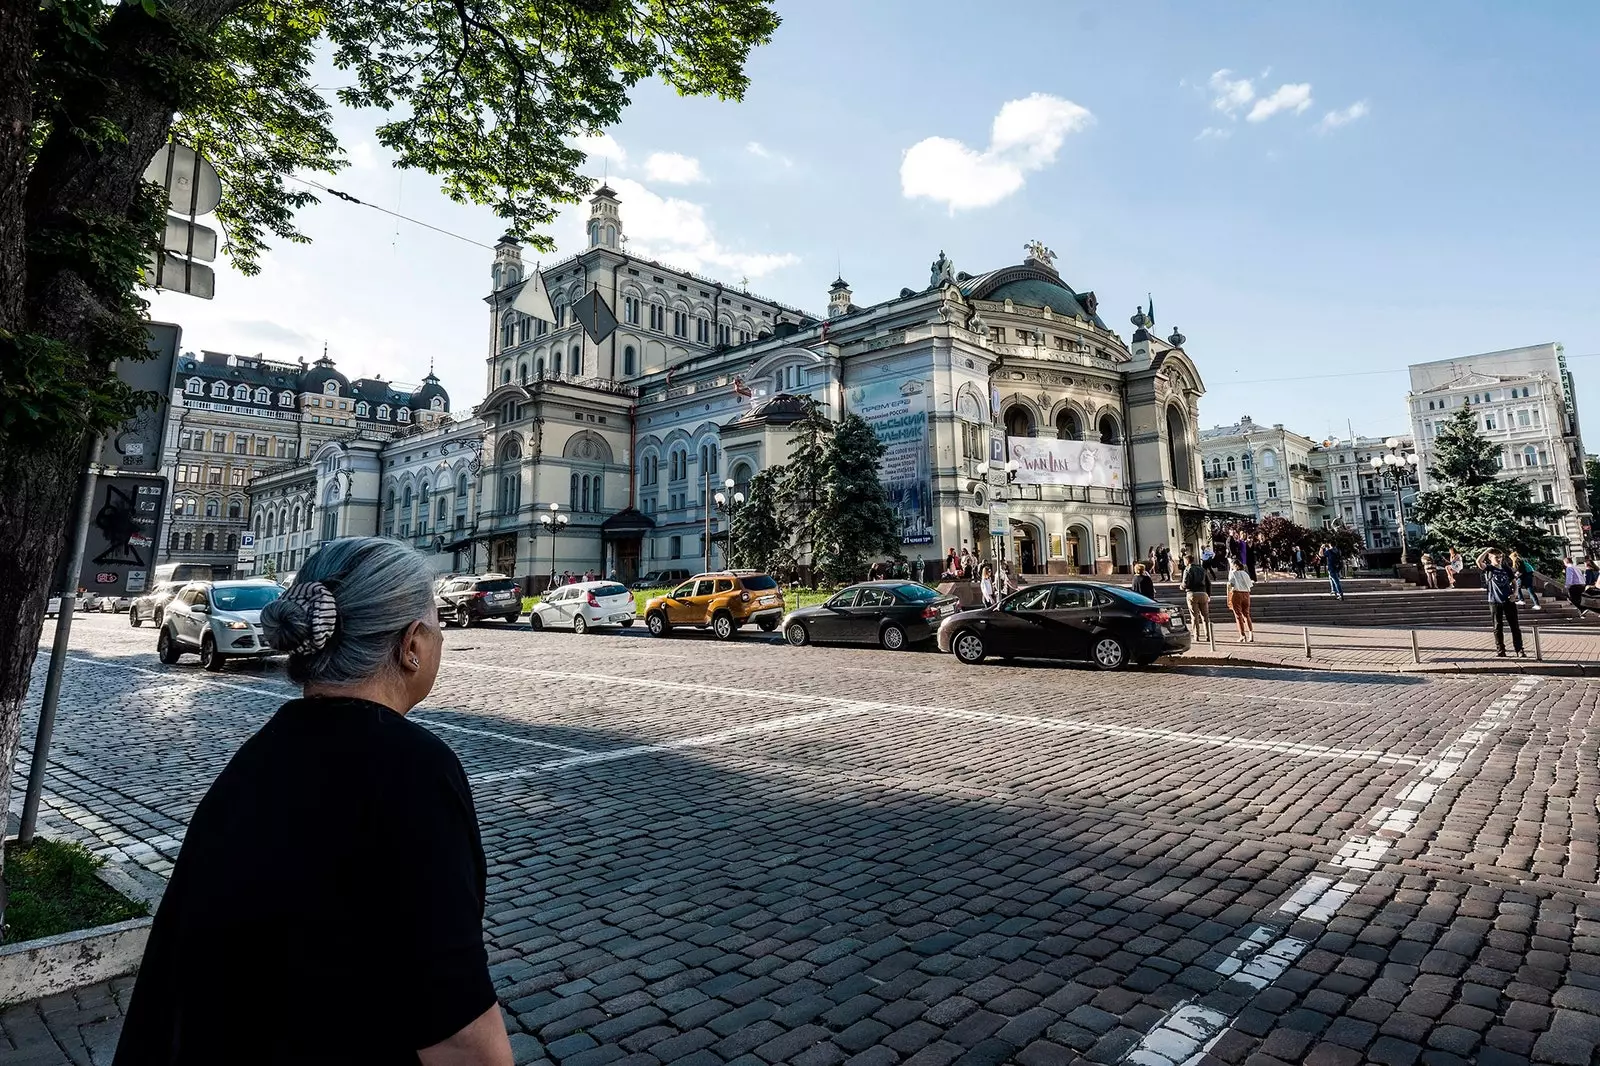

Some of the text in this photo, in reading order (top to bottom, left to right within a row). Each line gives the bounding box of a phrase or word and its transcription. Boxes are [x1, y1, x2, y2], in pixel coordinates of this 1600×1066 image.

[1557, 355, 1573, 409] СБЕРБАНК
[871, 410, 925, 431] ЛЬСЬКИЙ
[994, 441, 1001, 459] P
[244, 536, 252, 545] P
